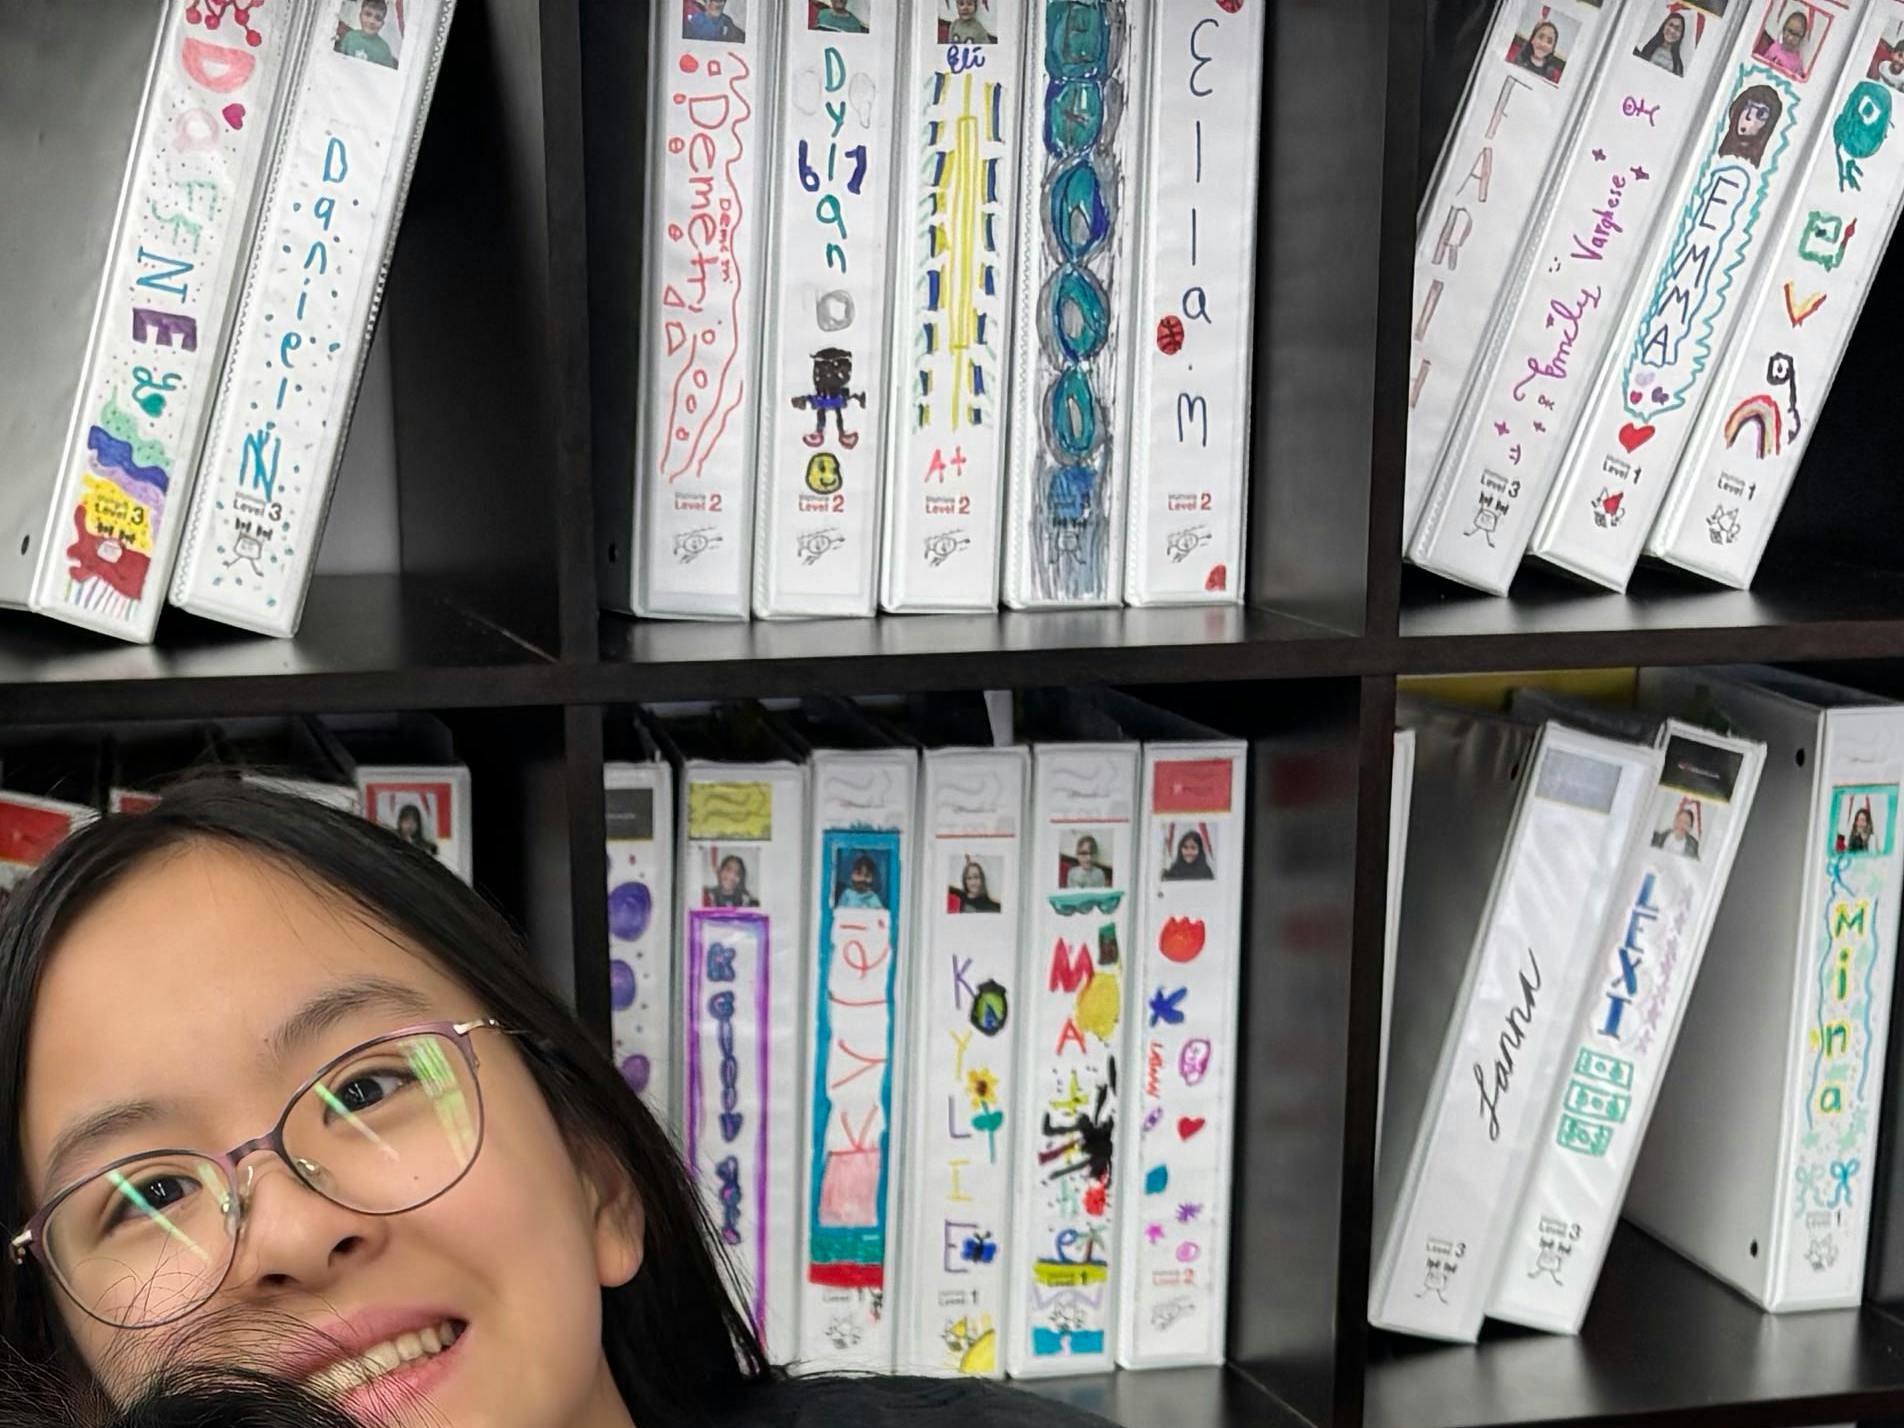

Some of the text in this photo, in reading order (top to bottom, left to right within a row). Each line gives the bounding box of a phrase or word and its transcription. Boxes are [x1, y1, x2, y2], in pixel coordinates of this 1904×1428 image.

[815, 46, 848, 274] Dylan
[276, 138, 348, 410] Daniel
[1641, 176, 1739, 362] EMMA
[1513, 286, 1602, 402] Emily
[1634, 465, 1641, 484] 1
[1509, 481, 1520, 498] 3
[1748, 483, 1756, 500] 1
[709, 494, 722, 512] 2
[832, 494, 844, 513] 2
[959, 496, 970, 515] 2
[1201, 493, 1211, 510] 2
[131, 507, 144, 525] 3
[269, 502, 282, 521] 3
[1819, 905, 1866, 1114] Mina
[947, 954, 977, 1274] KYLIE
